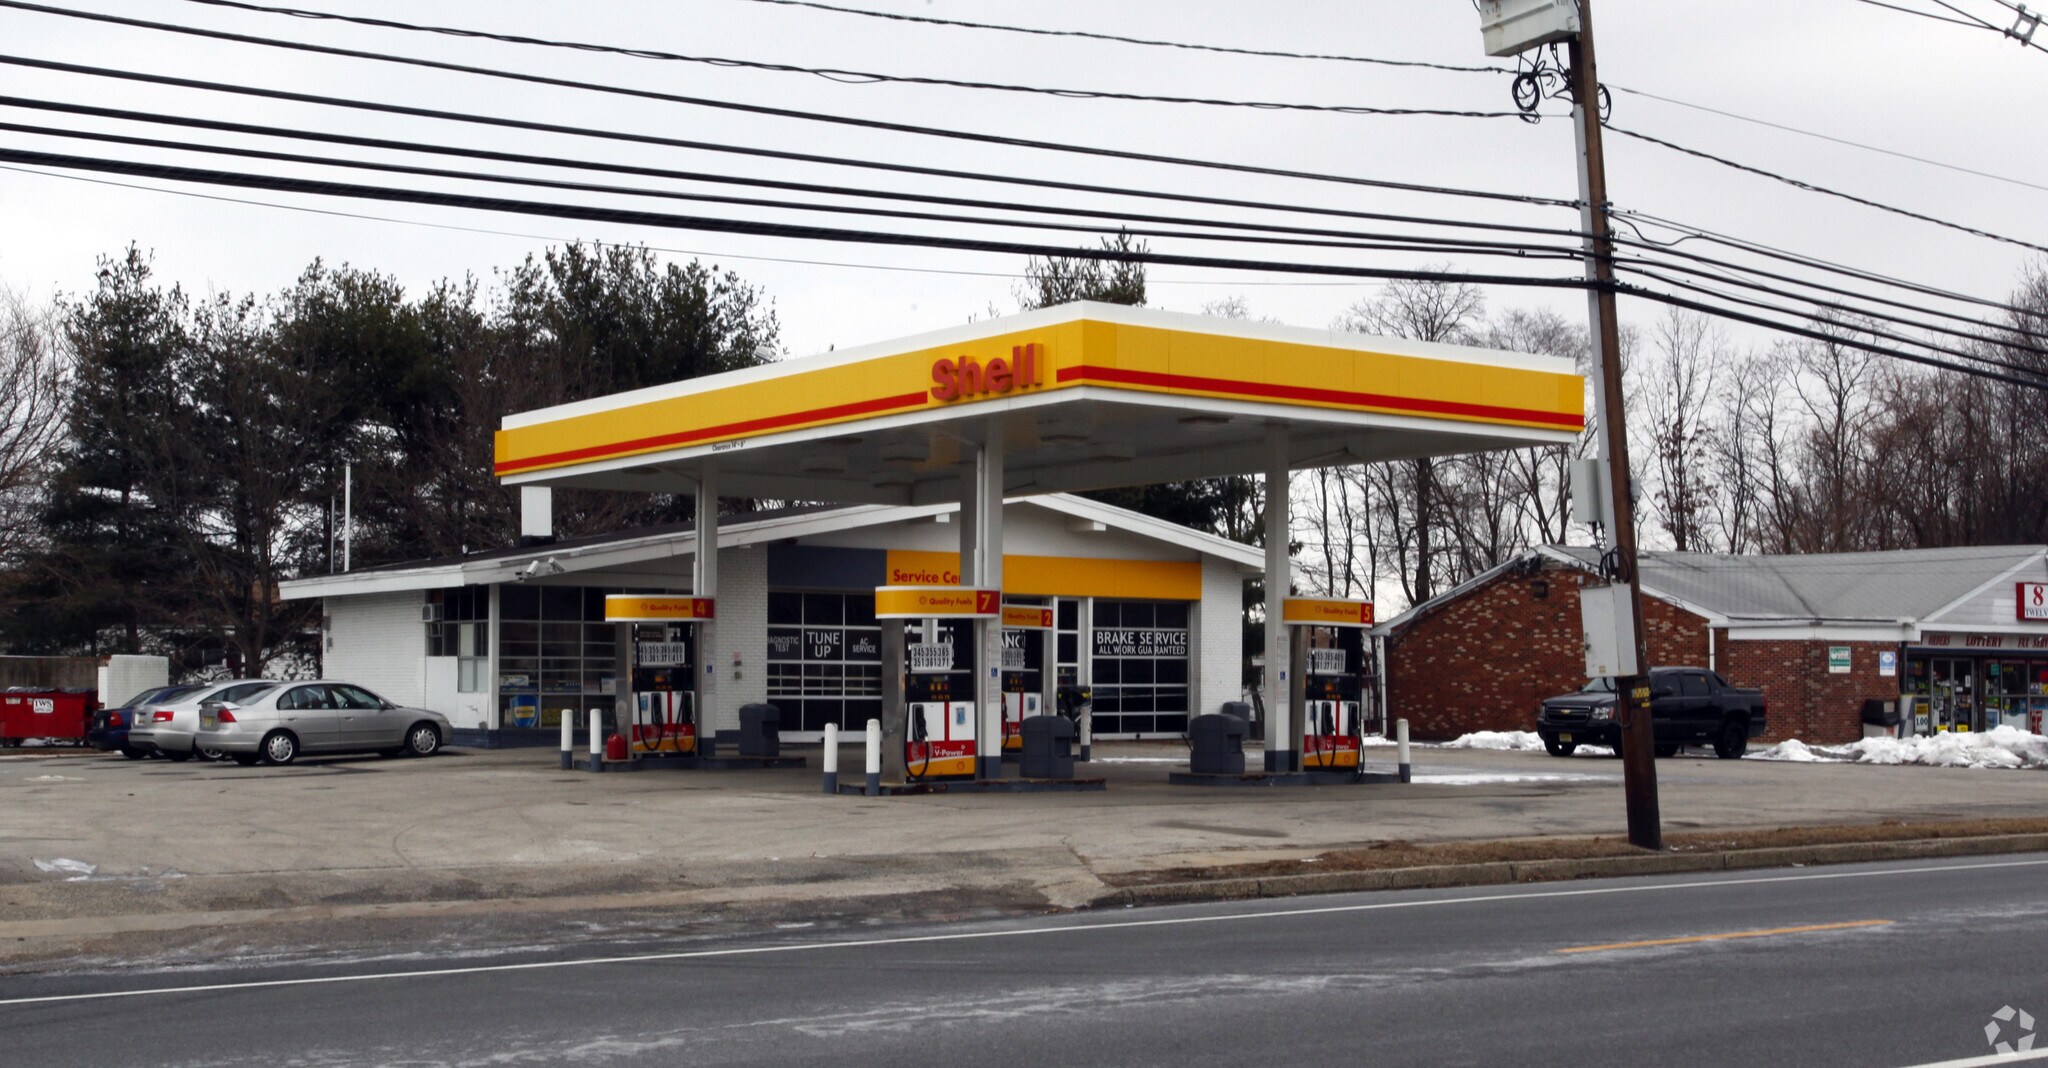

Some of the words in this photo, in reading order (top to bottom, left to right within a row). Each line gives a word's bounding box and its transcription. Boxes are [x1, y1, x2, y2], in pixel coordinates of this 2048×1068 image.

[931, 343, 1042, 401] Shell
[893, 569, 939, 583] Service
[943, 571, 960, 583] Ce
[929, 597, 955, 606] Quality
[956, 597, 972, 605] Fuels
[981, 594, 991, 610] 7
[2033, 585, 2044, 606] 8
[674, 604, 688, 612] Fuels
[696, 601, 706, 615] 4
[1323, 607, 1343, 616] Quality
[1344, 608, 1358, 616] Fuels
[1363, 606, 1370, 621] 5
[1044, 612, 1051, 625] 2
[768, 636, 799, 645] IAGNOSTIC
[806, 632, 840, 645] TUNE
[860, 637, 868, 645] AC
[1097, 631, 1135, 644] BRAKE
[1966, 635, 2004, 648] LOTTERY
[775, 644, 790, 652] TEST
[814, 645, 831, 658] UP
[852, 645, 876, 653] SERVICE
[913, 647, 925, 657] 345
[925, 647, 937, 657] 355
[937, 647, 949, 657] 365
[1099, 645, 1112, 654] ALL
[913, 657, 925, 667] 351
[925, 657, 937, 667] 361
[937, 657, 949, 667] 371
[934, 749, 964, 757] V-Power
